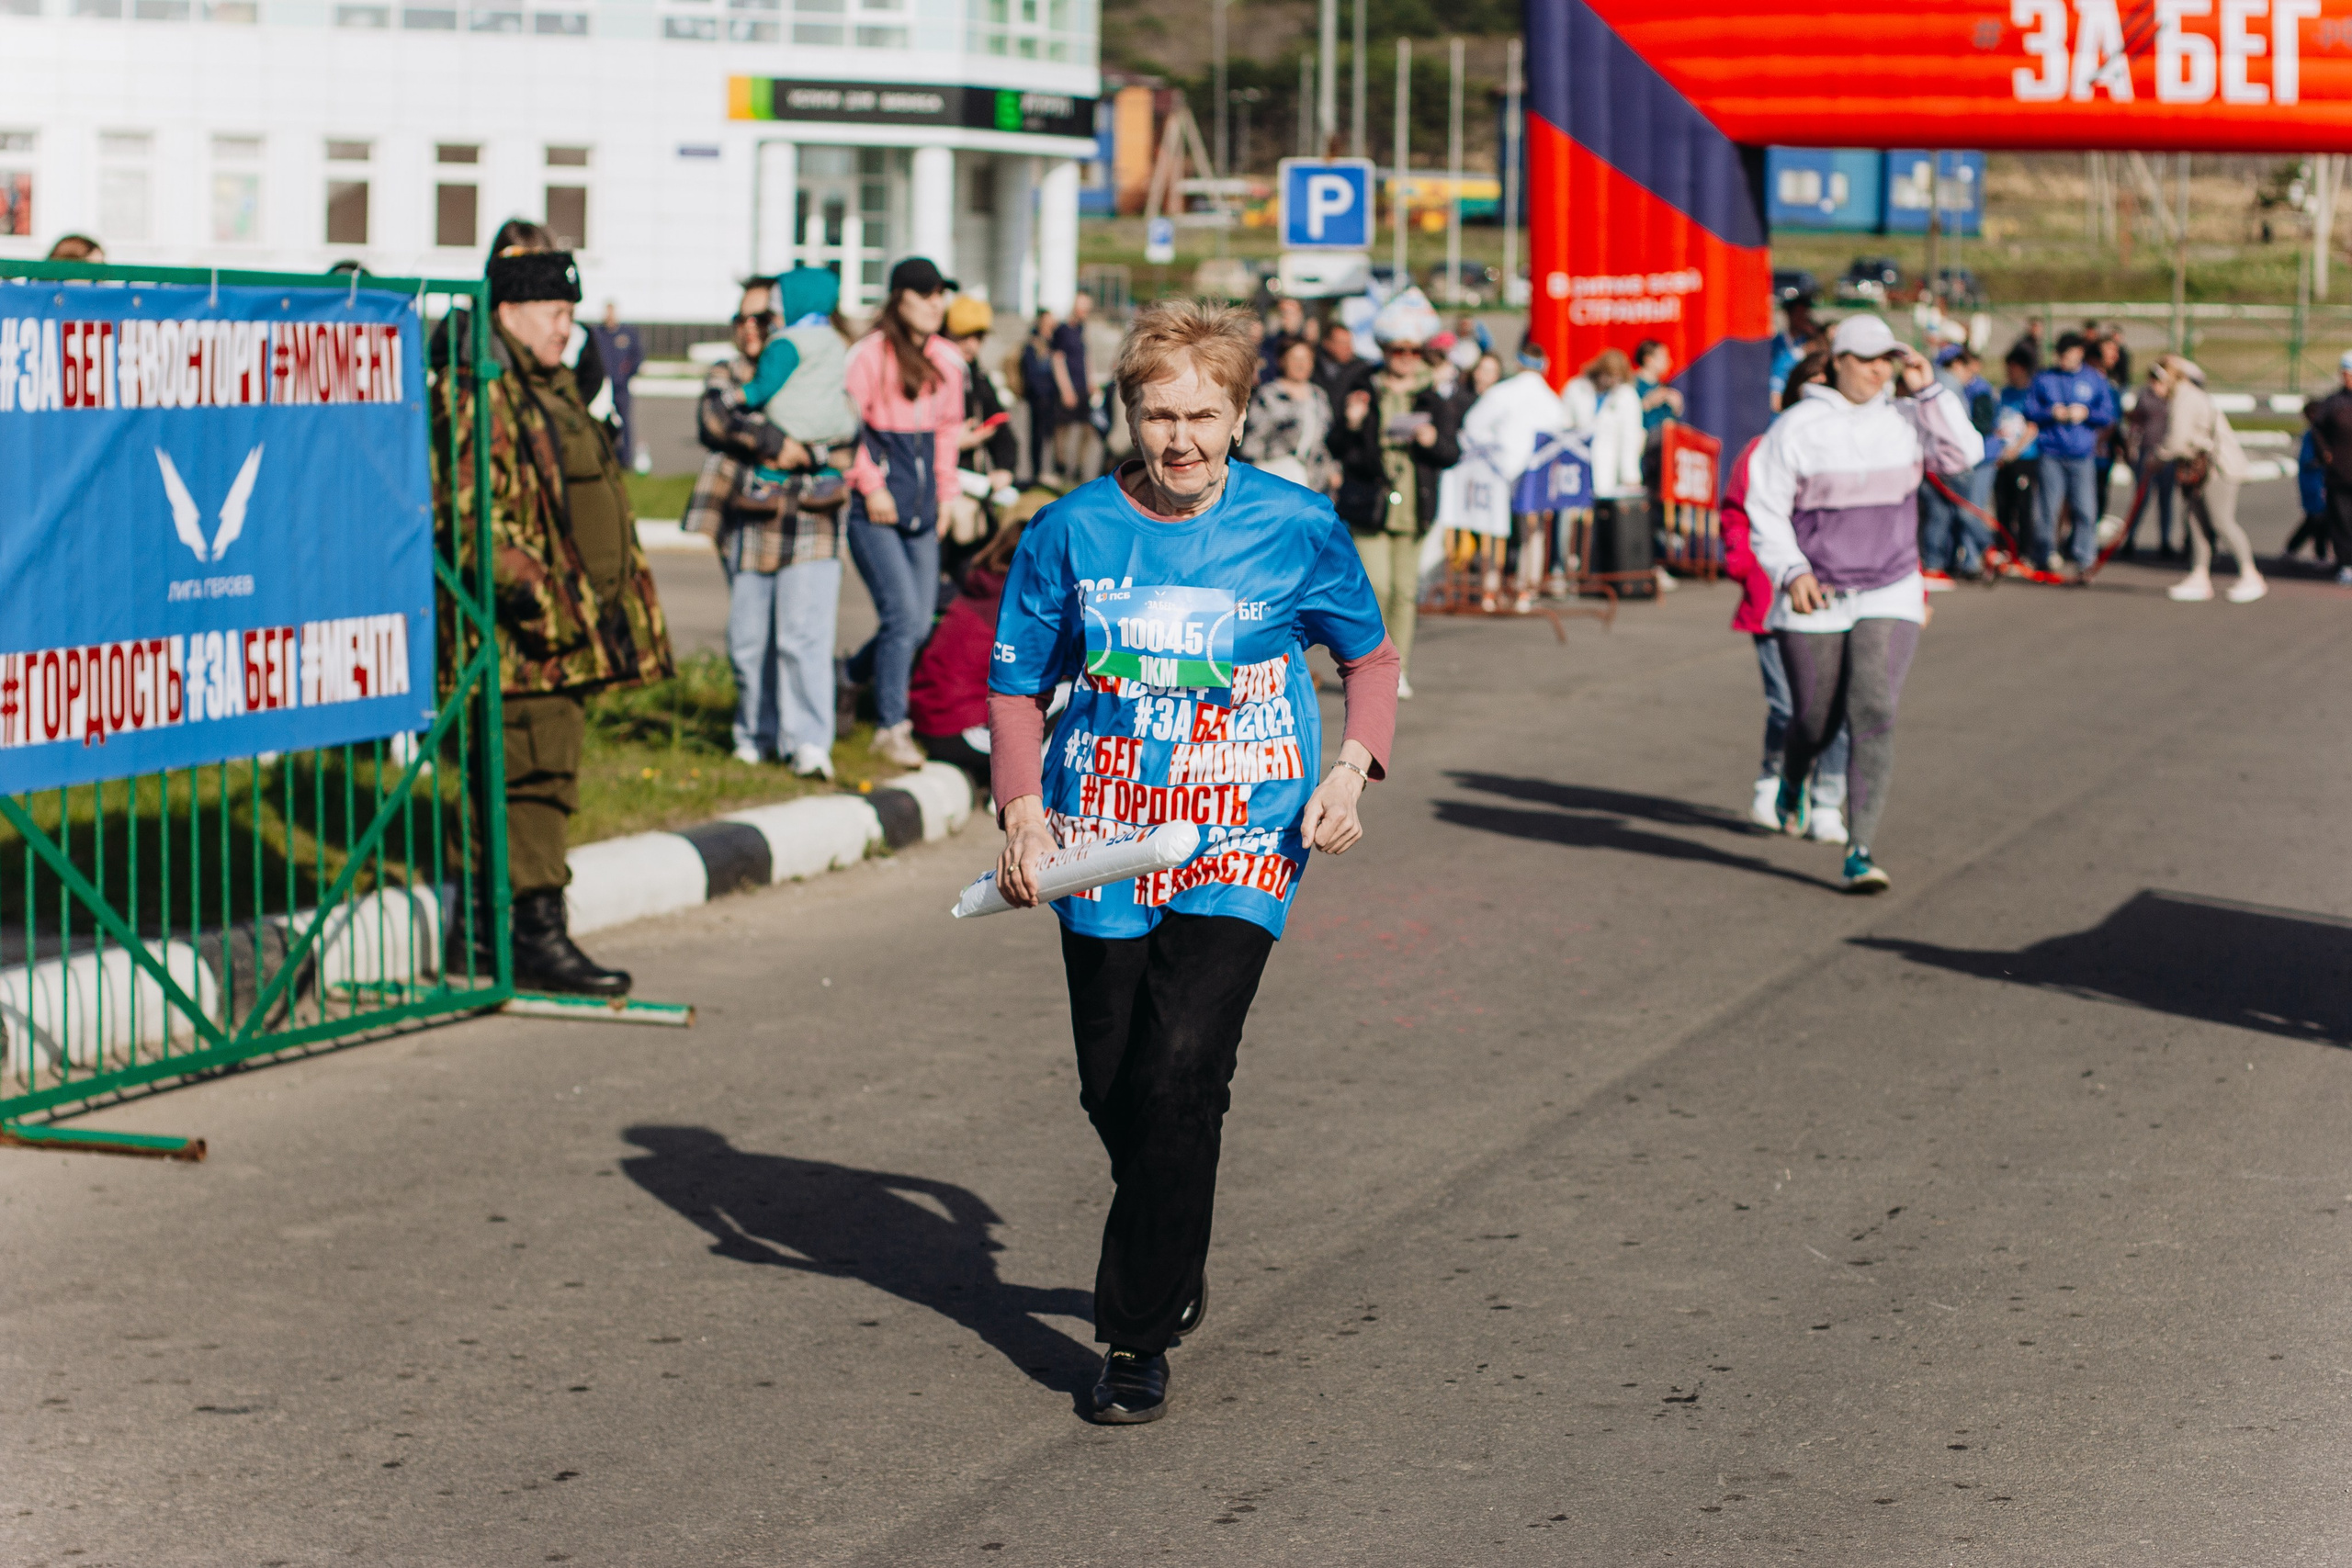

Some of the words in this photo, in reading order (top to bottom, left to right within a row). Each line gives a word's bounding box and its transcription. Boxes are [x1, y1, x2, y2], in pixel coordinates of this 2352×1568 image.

[1307, 174, 1355, 240] P
[119, 319, 268, 409] #ВОСТОРГ
[272, 321, 402, 404] #МОМЕНТ
[1109, 592, 1131, 601] ПСБ
[1117, 617, 1204, 655] 10045
[0, 635, 183, 747] #ГОРДОСТЬ
[187, 626, 298, 722] #ЗАБЕГ
[301, 613, 410, 706] #МЕЧТА
[1080, 774, 1251, 826] #ГОРДОСТЬ
